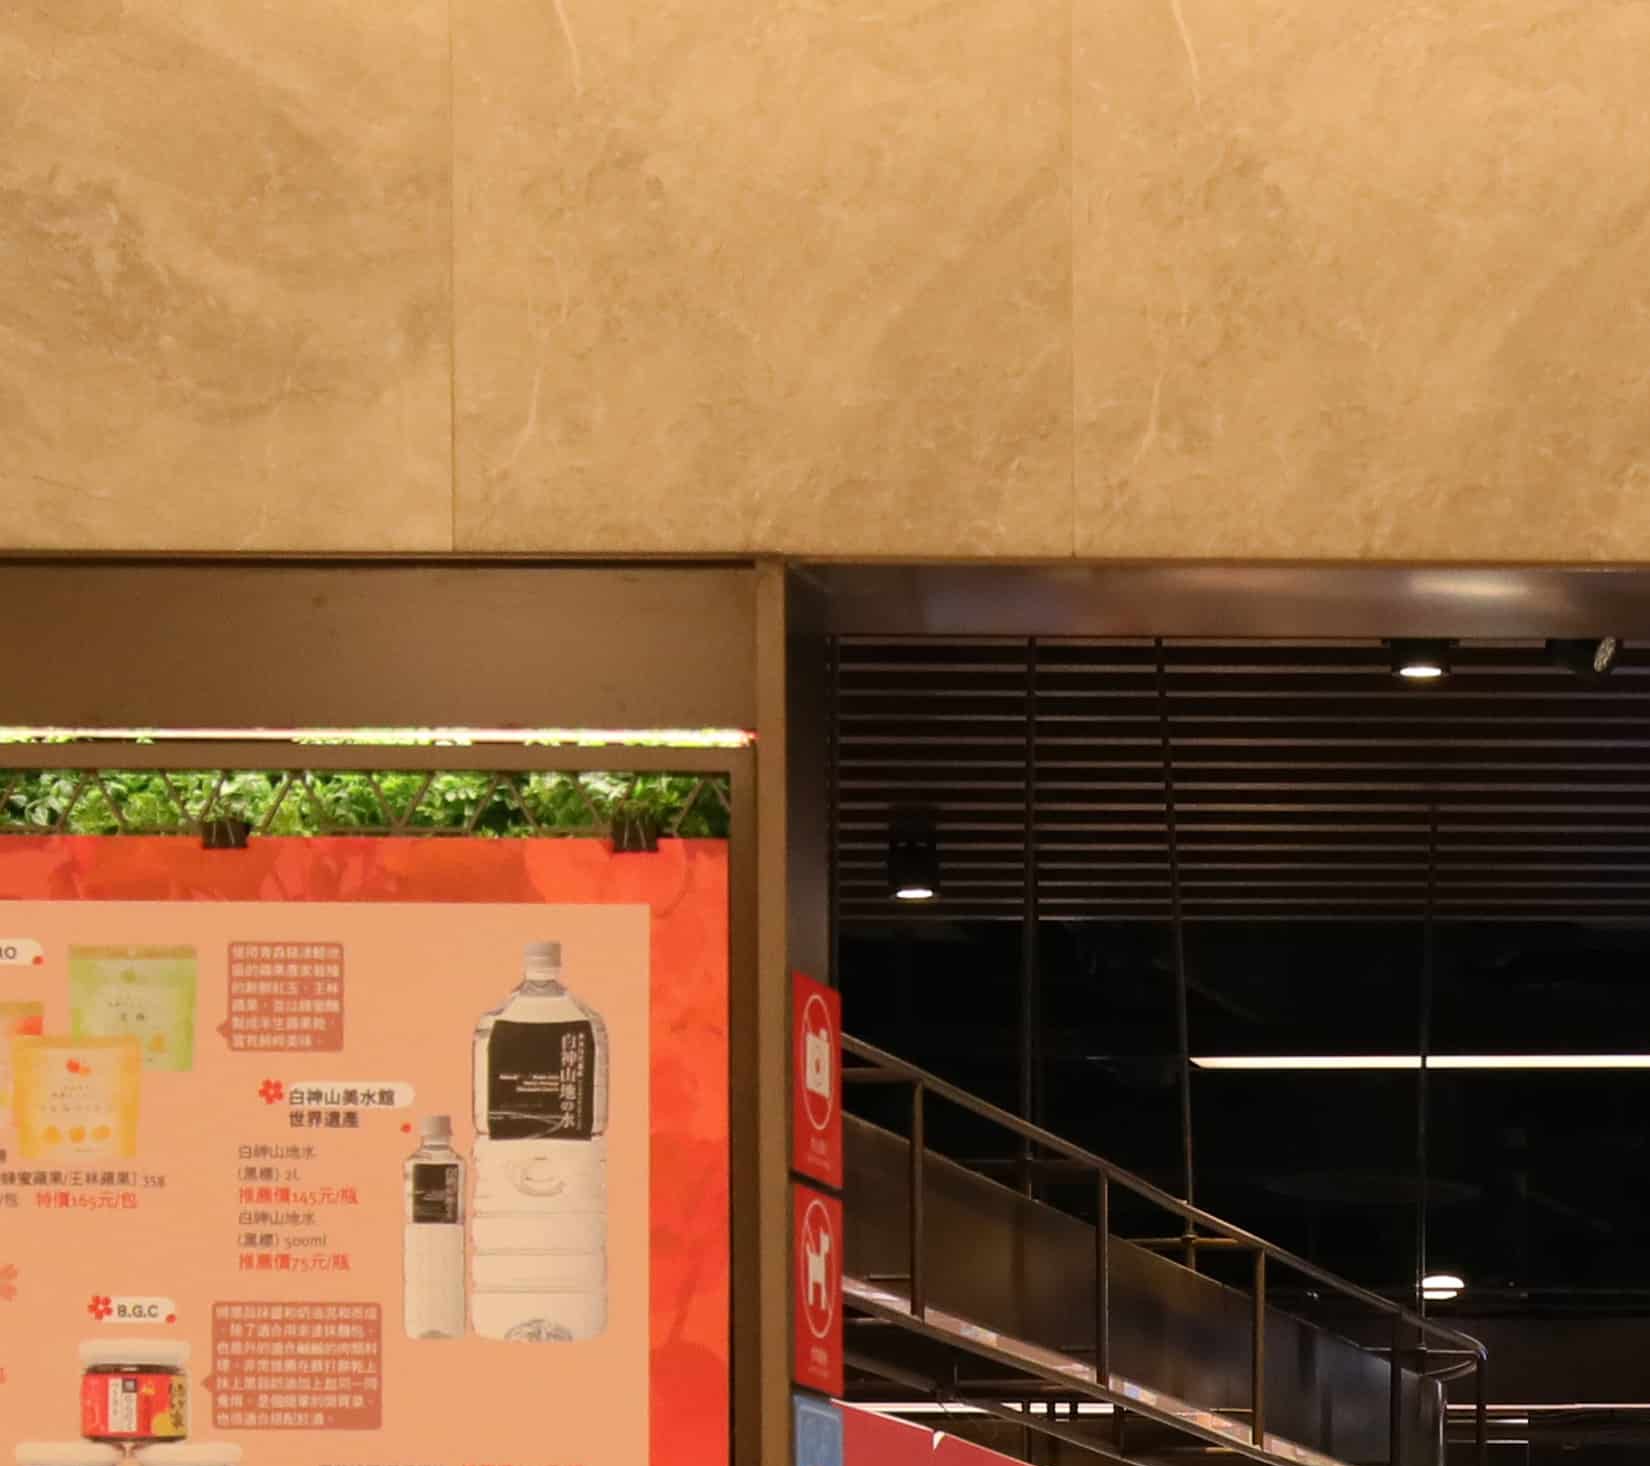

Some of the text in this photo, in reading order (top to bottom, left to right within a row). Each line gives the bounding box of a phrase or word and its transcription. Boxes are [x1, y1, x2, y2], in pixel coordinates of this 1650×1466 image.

[288, 1111, 359, 1128] 世界遺產
[117, 1304, 159, 1319] B.G.C
